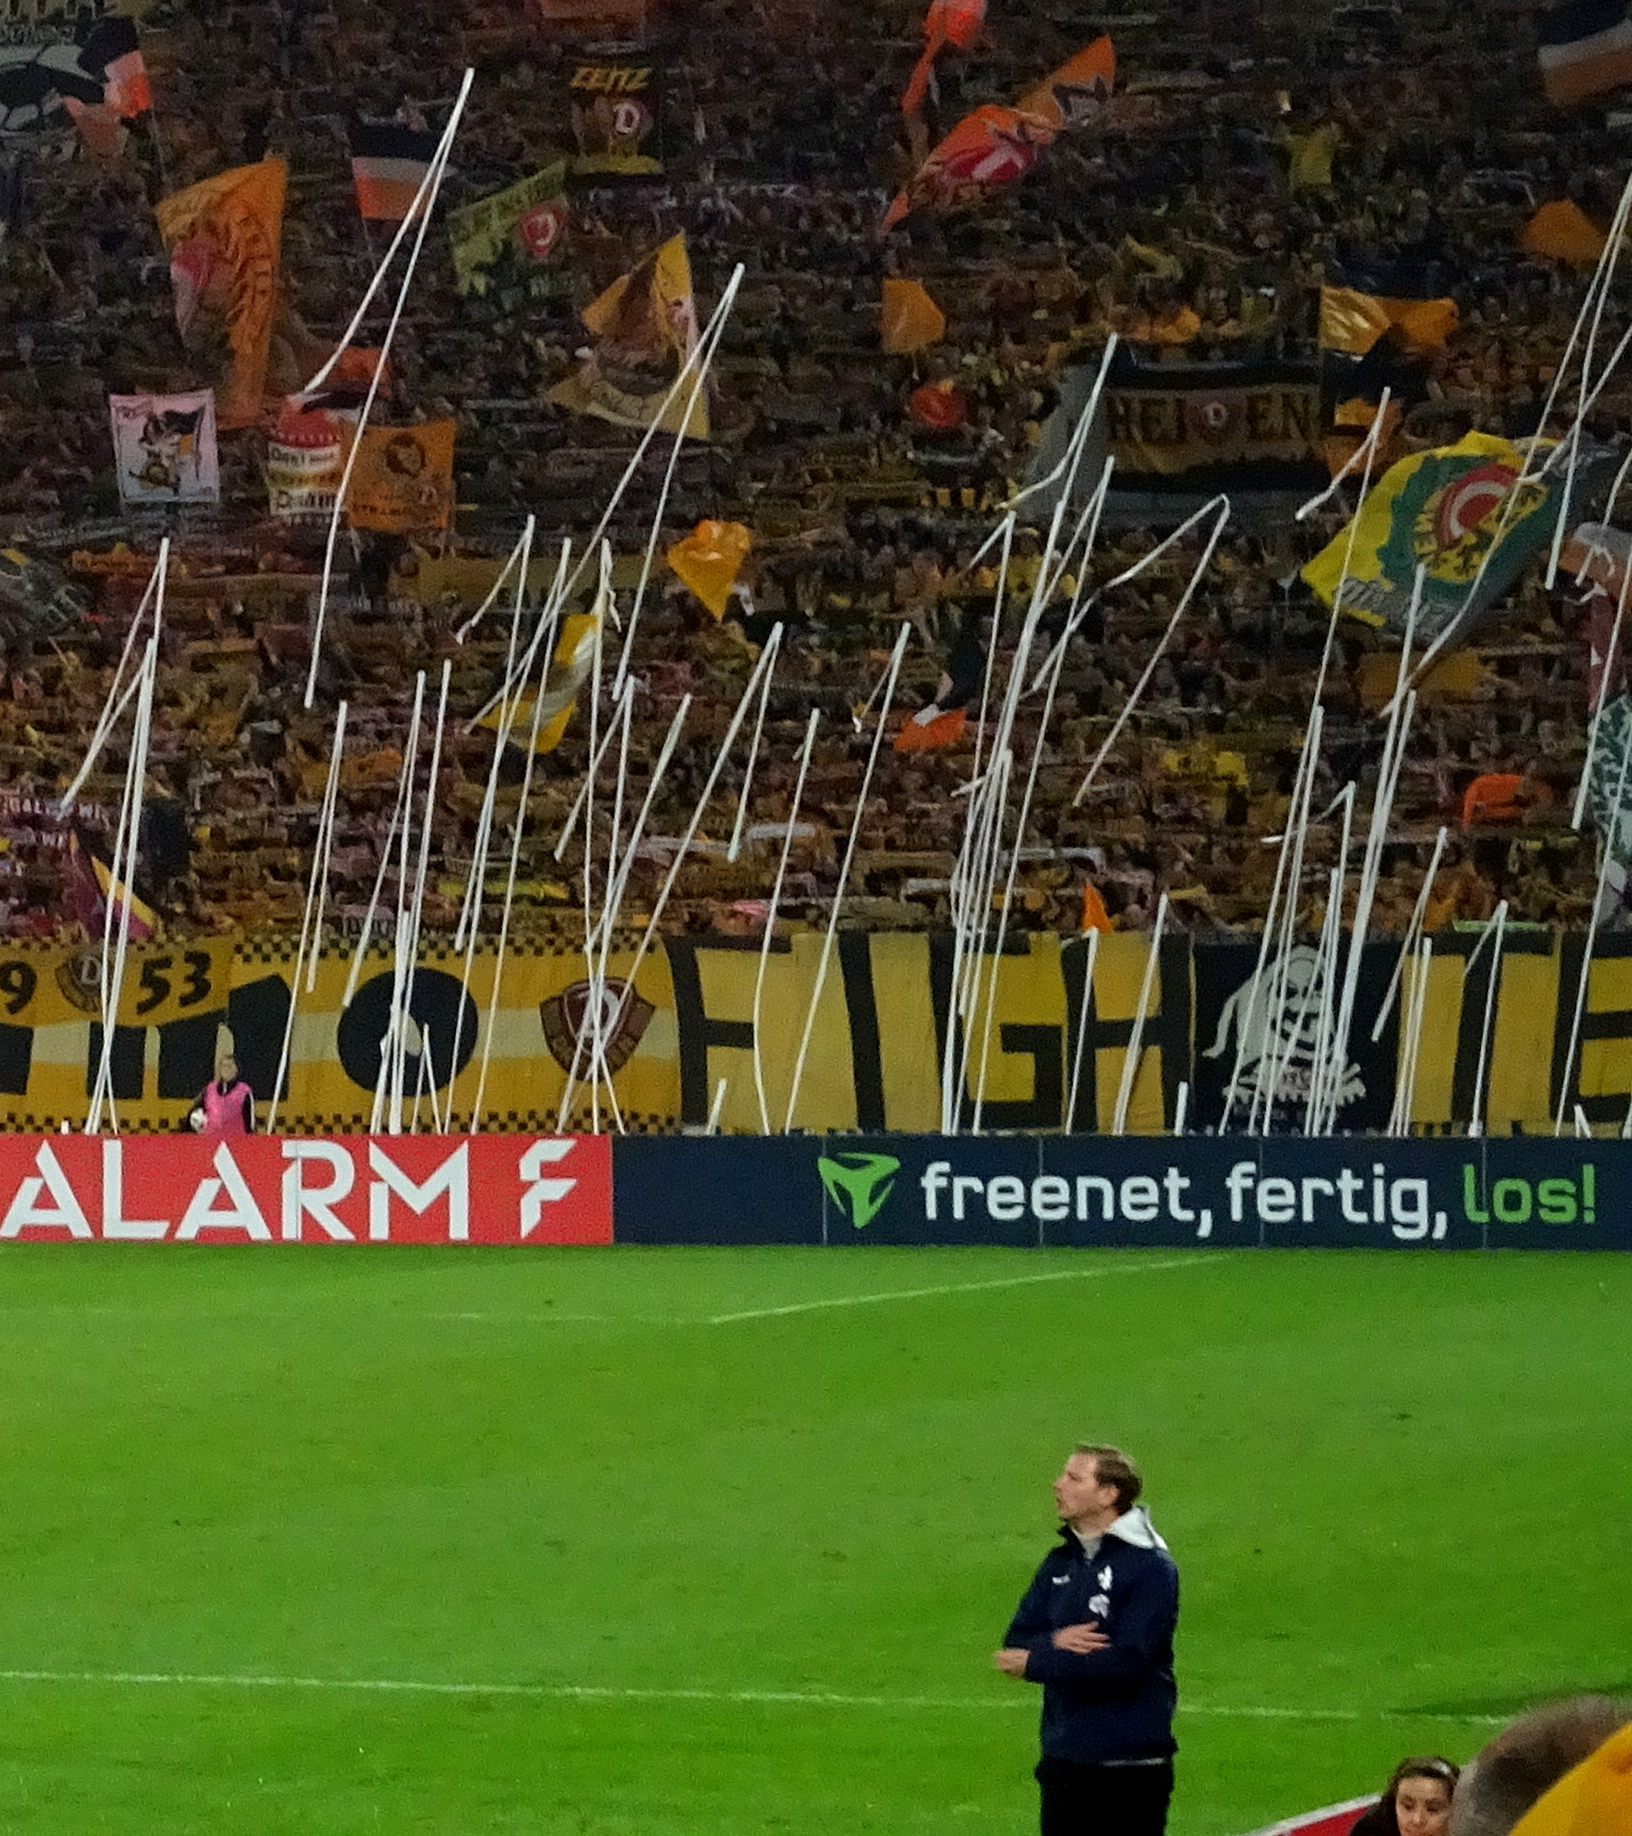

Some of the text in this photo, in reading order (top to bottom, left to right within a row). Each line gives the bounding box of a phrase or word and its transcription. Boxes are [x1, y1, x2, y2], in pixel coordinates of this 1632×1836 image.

[136, 950, 213, 1016] 53
[920, 1160, 1596, 1240] freenet, fertig, los!
